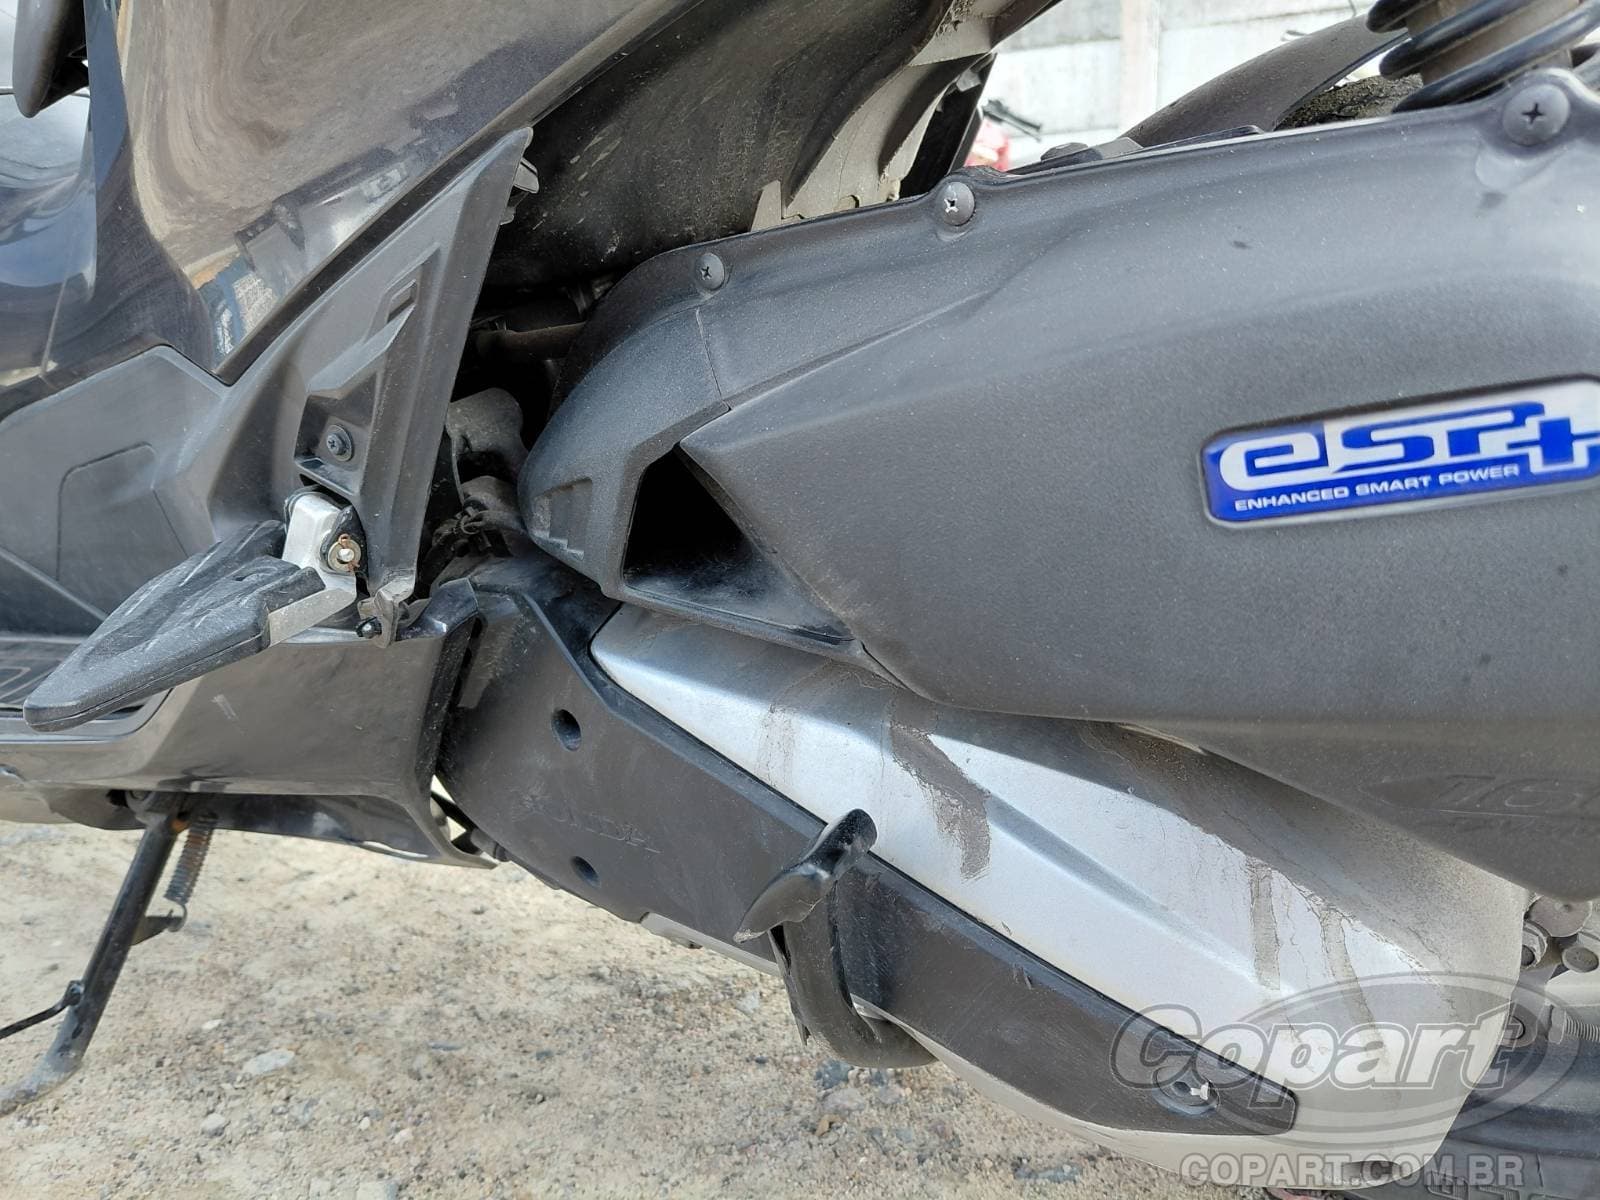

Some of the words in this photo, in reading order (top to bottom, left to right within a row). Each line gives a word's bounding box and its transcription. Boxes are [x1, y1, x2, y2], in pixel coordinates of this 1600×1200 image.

[1234, 485, 1350, 512] ENHANCED
[1356, 475, 1431, 497] SMART
[1438, 463, 1520, 487] POWER
